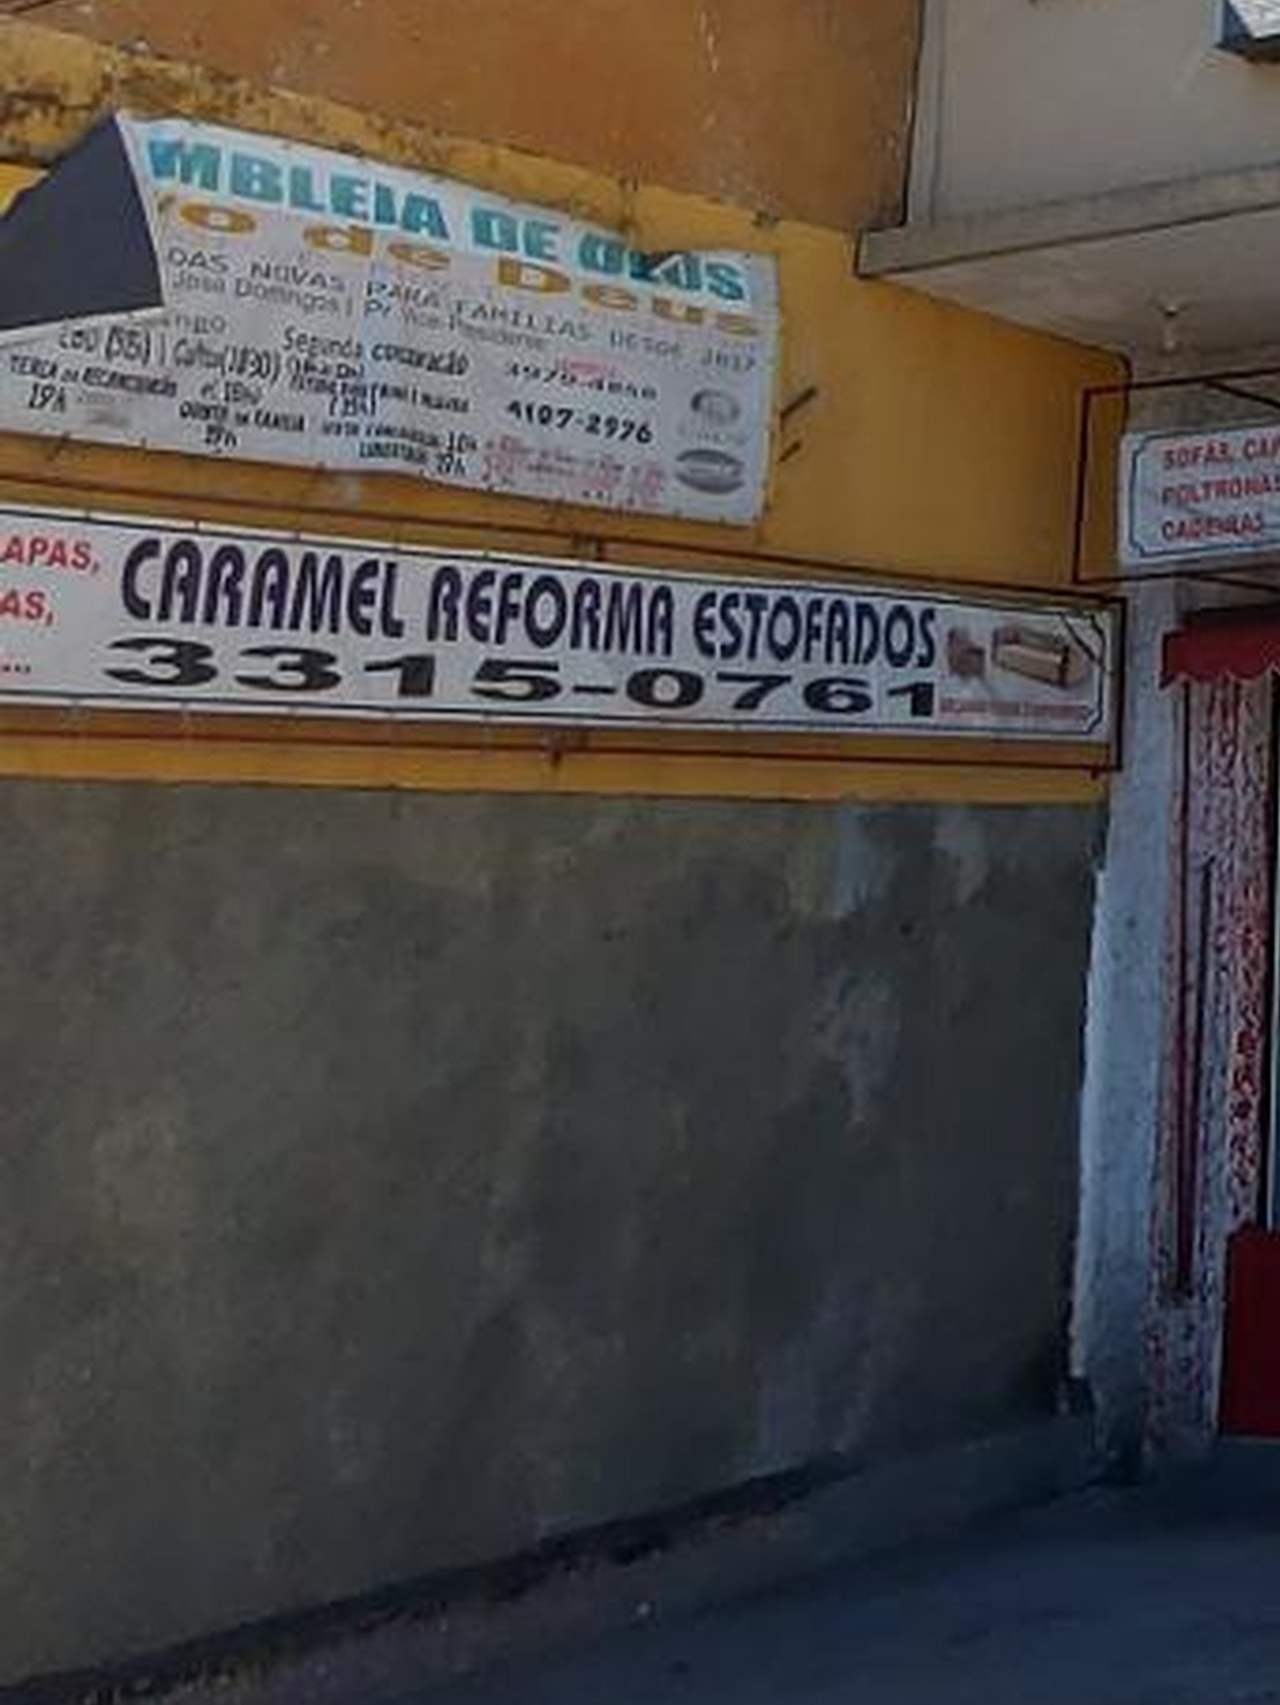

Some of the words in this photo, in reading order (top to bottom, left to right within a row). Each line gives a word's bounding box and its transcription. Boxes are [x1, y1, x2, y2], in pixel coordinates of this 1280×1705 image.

[471, 207, 557, 260] DE
[497, 258, 758, 338] Deus
[121, 538, 404, 638] CARAMEL
[427, 565, 672, 658] REFORMA
[692, 592, 935, 669] ESTOFADOS
[104, 637, 934, 718] 3315-0761
